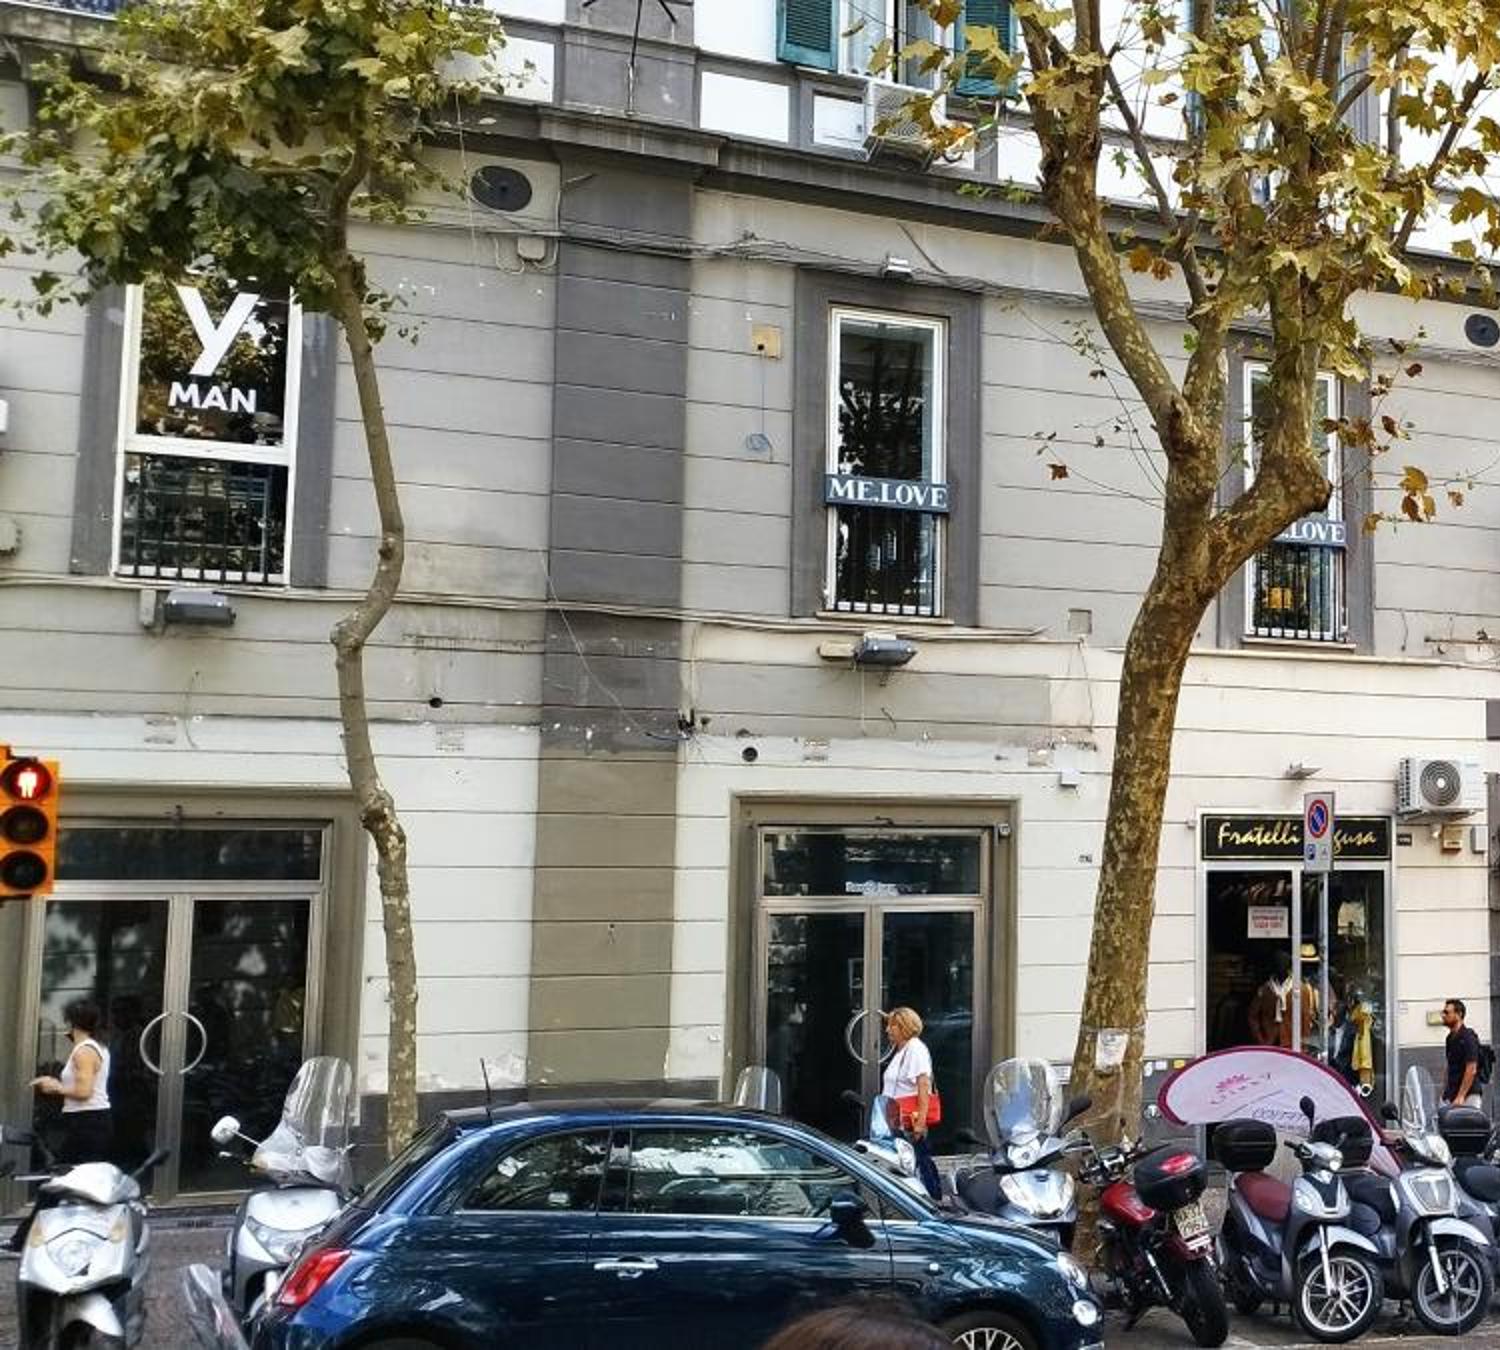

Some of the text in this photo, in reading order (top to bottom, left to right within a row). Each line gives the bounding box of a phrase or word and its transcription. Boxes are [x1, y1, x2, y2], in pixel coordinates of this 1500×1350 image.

[168, 381, 257, 413] MAN
[828, 478, 948, 508] ME.LOVE
[1217, 821, 1300, 849] Fratelli
